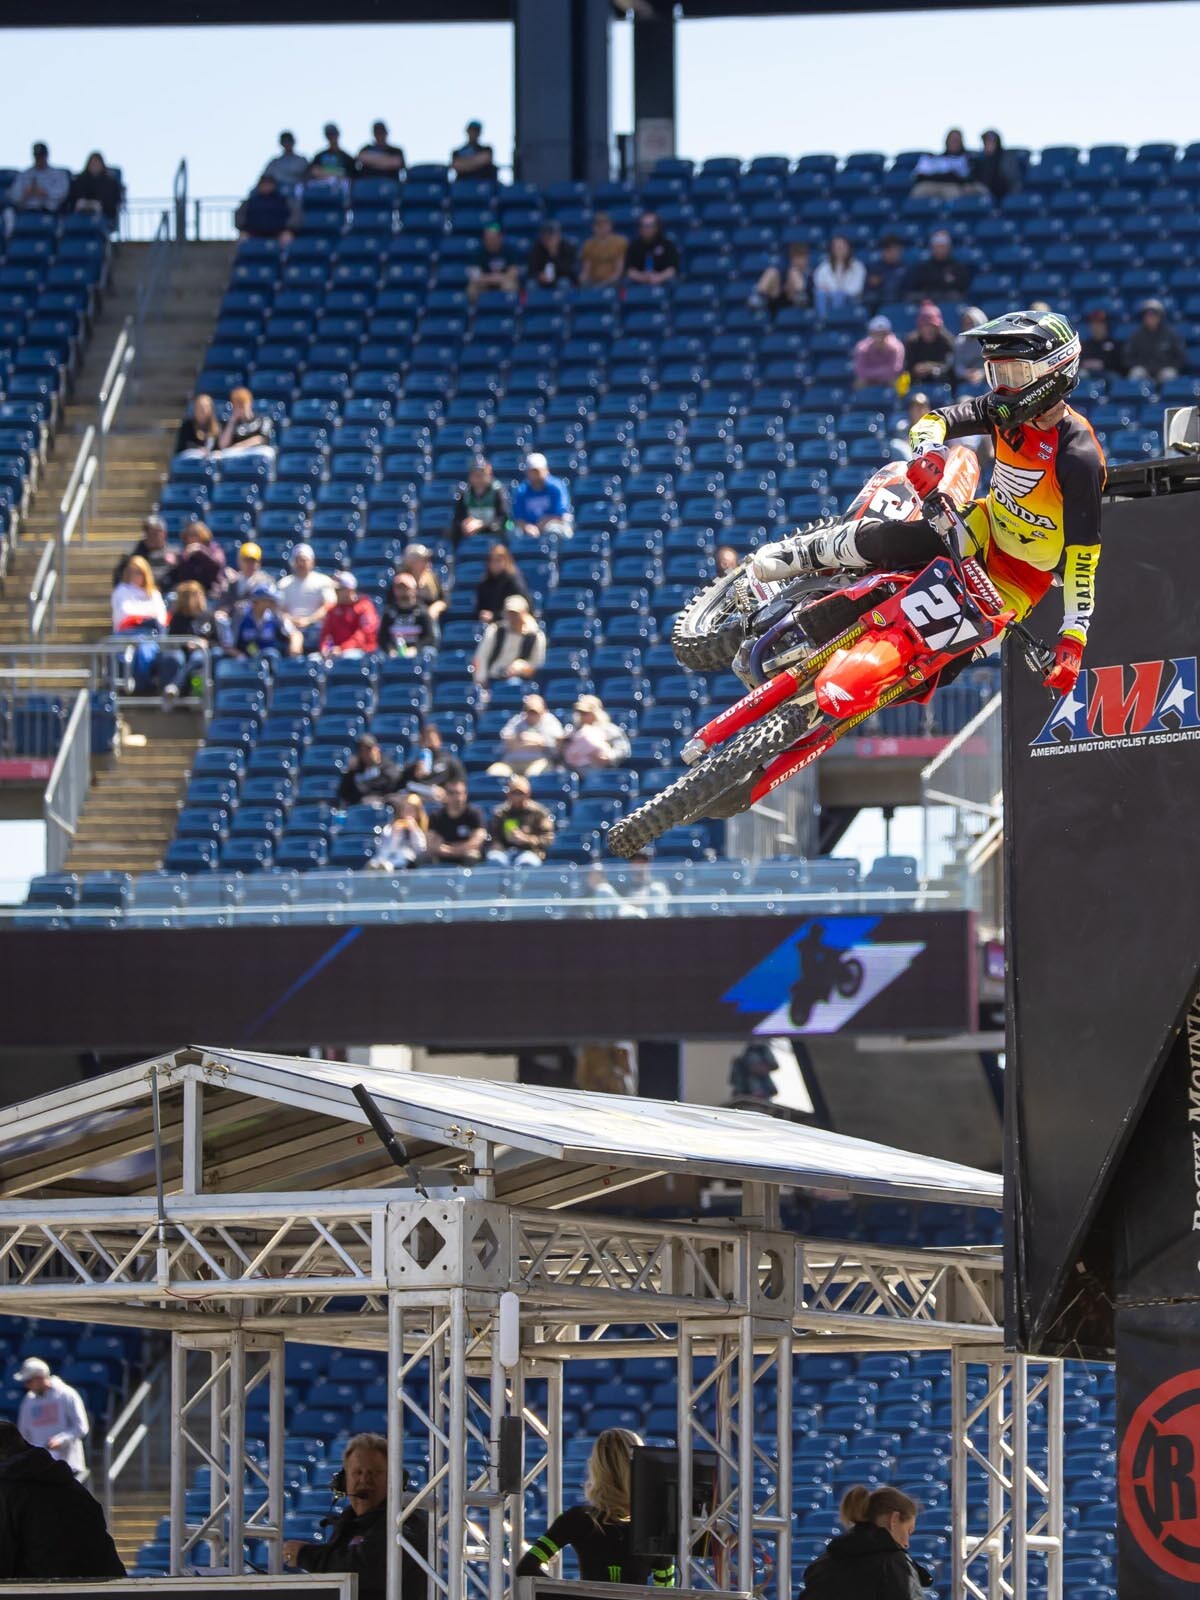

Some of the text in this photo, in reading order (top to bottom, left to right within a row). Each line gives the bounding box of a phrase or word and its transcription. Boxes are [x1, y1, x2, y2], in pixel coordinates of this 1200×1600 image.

[1019, 379, 1057, 407] MONSTER
[991, 485, 1057, 530] ONDA
[1075, 552, 1092, 612] RACING
[900, 583, 979, 652] 21
[716, 680, 775, 725] DUNLOP
[769, 744, 827, 791] DUNLOP
[1030, 743, 1077, 758] AMERICAN
[1078, 736, 1147, 753] MOTORCYCLIST
